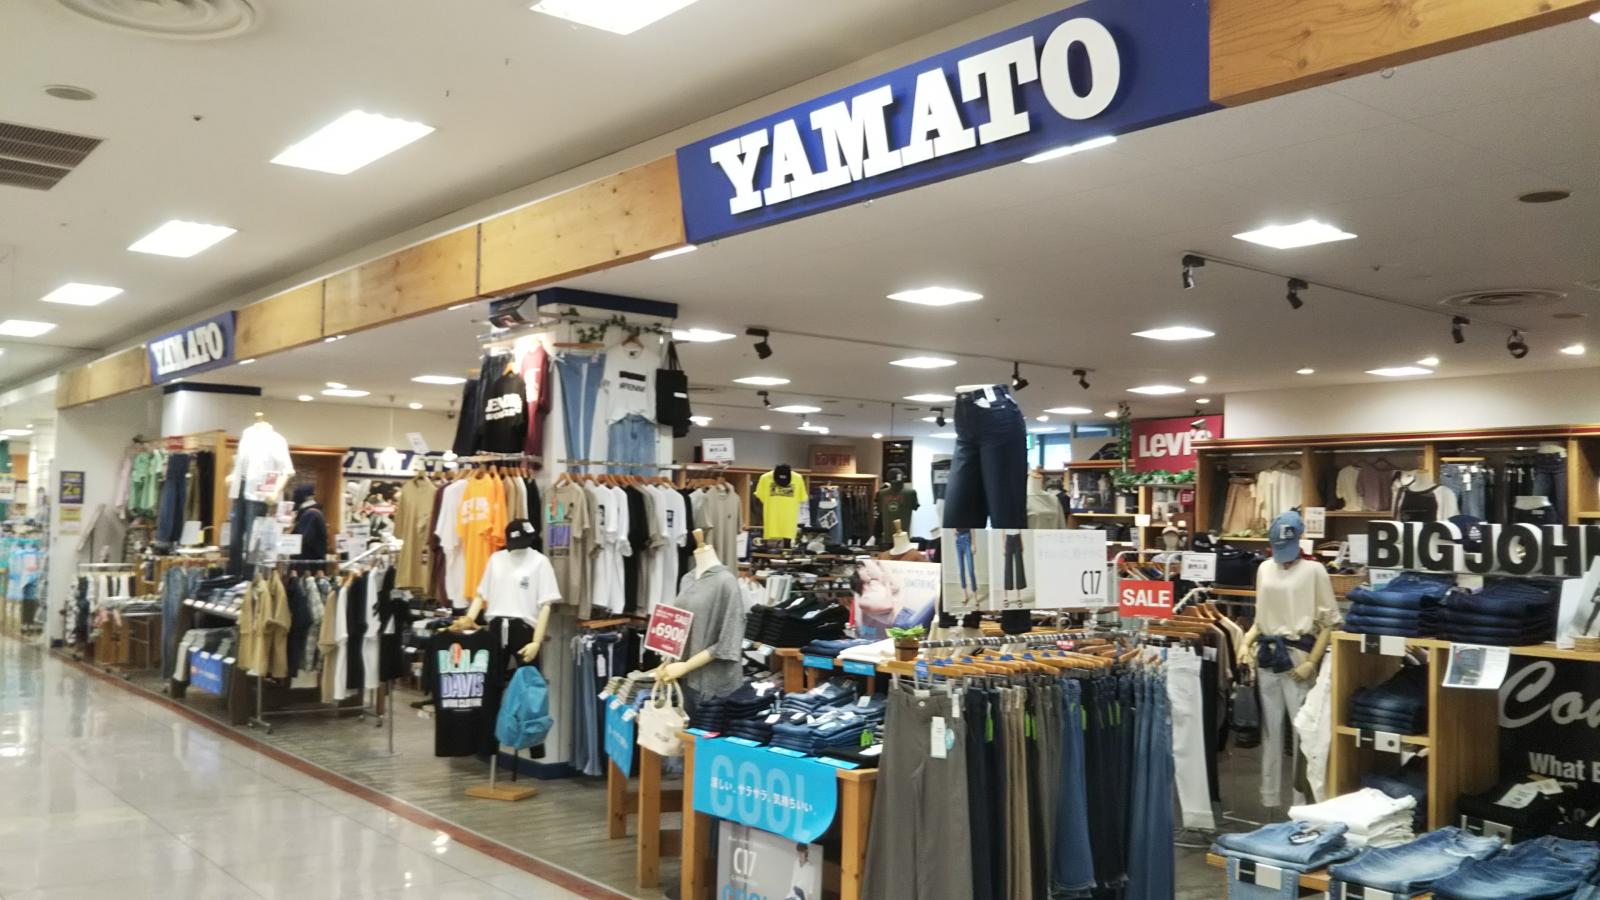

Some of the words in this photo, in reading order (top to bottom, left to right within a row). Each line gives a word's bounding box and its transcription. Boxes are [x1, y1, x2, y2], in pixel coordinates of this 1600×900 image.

[709, 17, 1121, 215] YAMATO
[150, 322, 224, 375] YAMATO
[1368, 521, 1455, 572] BIG
[1082, 570, 1102, 595] C17
[1122, 588, 1171, 608] SALE
[441, 673, 485, 698] DAVIS
[1528, 751, 1586, 781] What
[710, 754, 812, 840] COOL
